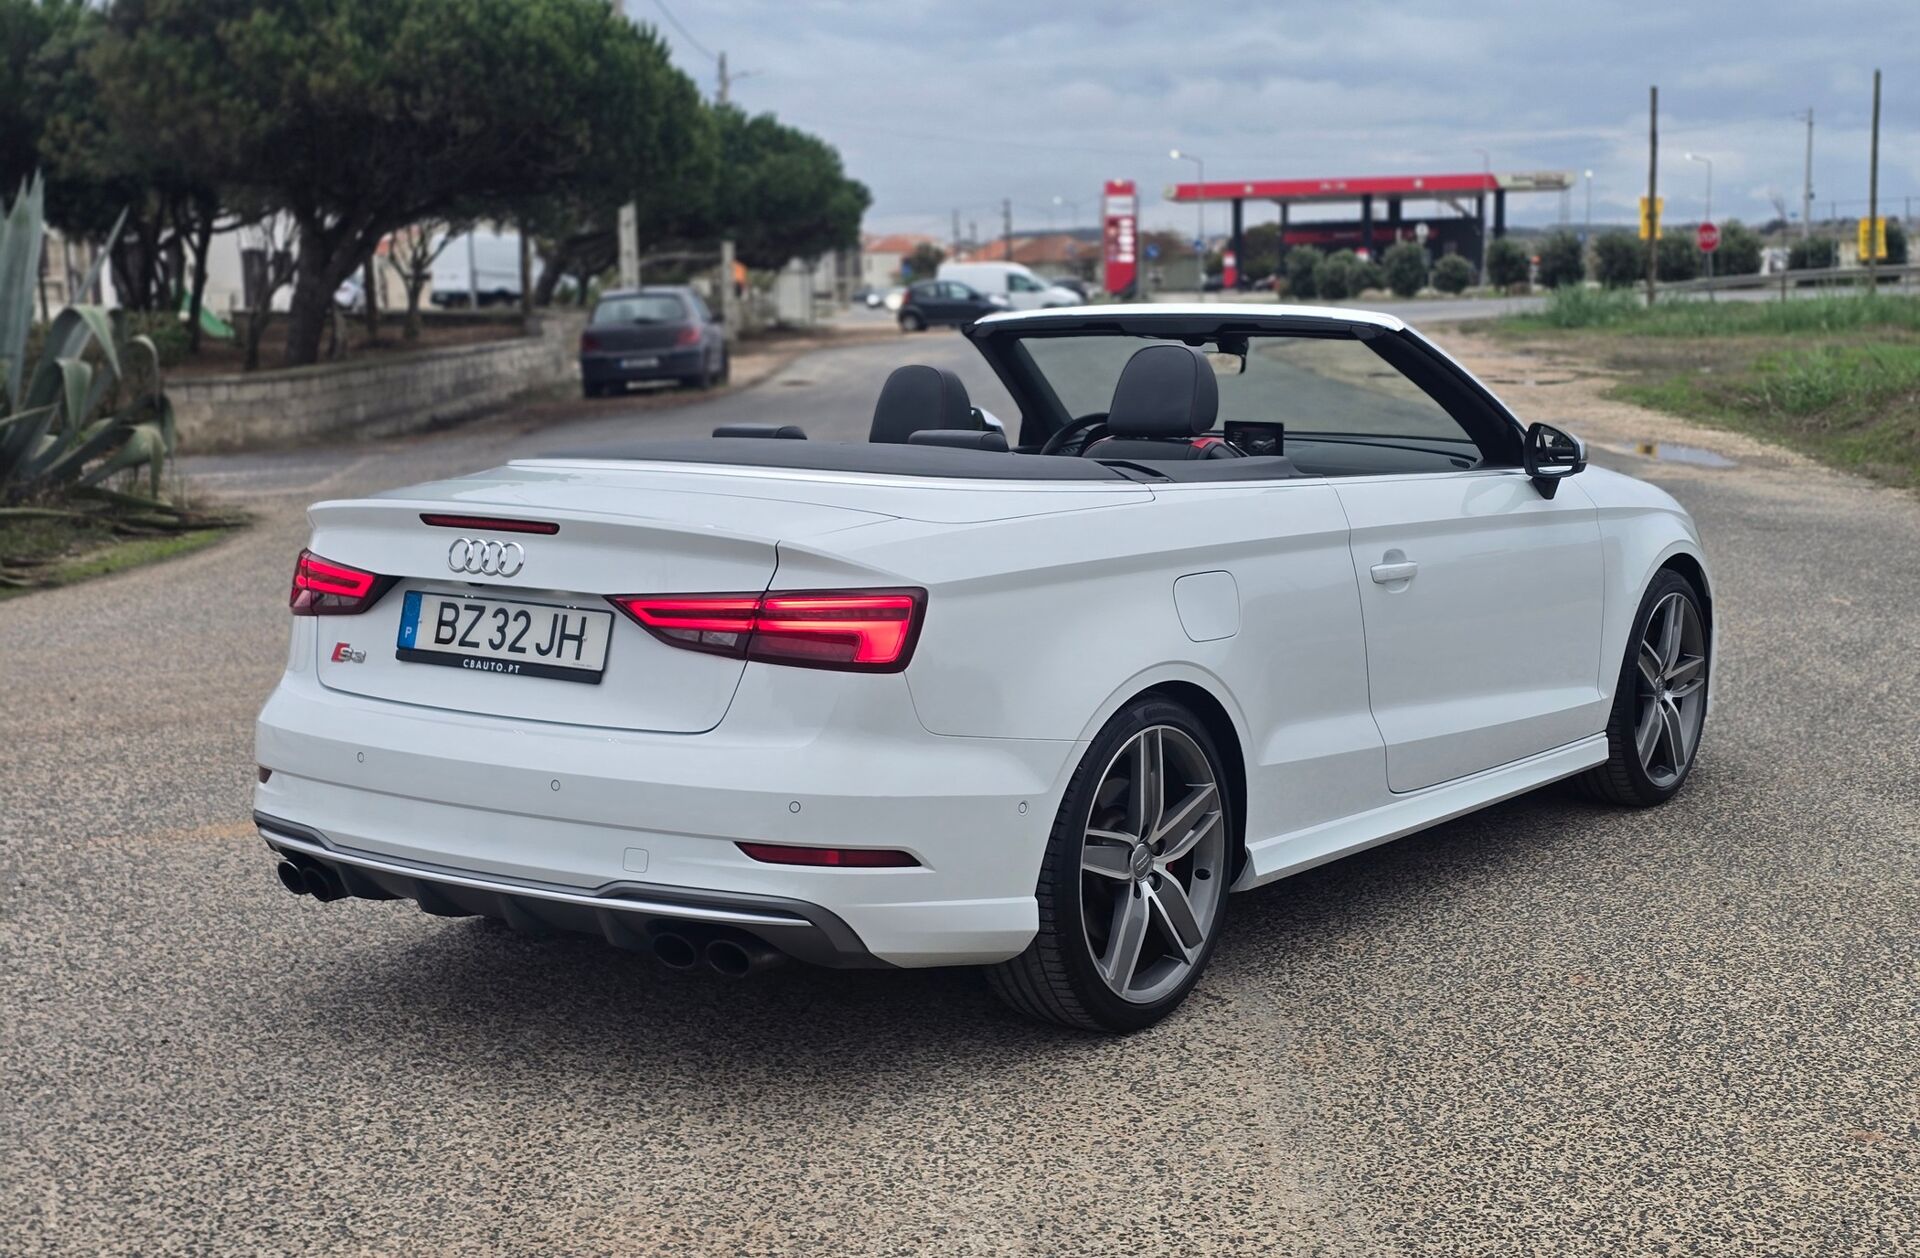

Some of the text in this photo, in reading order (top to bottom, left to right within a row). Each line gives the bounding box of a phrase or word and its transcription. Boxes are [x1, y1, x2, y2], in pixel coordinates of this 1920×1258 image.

[404, 626, 412, 639] P
[434, 602, 587, 660] BZ 32 JH
[463, 659, 520, 673] CBAUTO.PT
